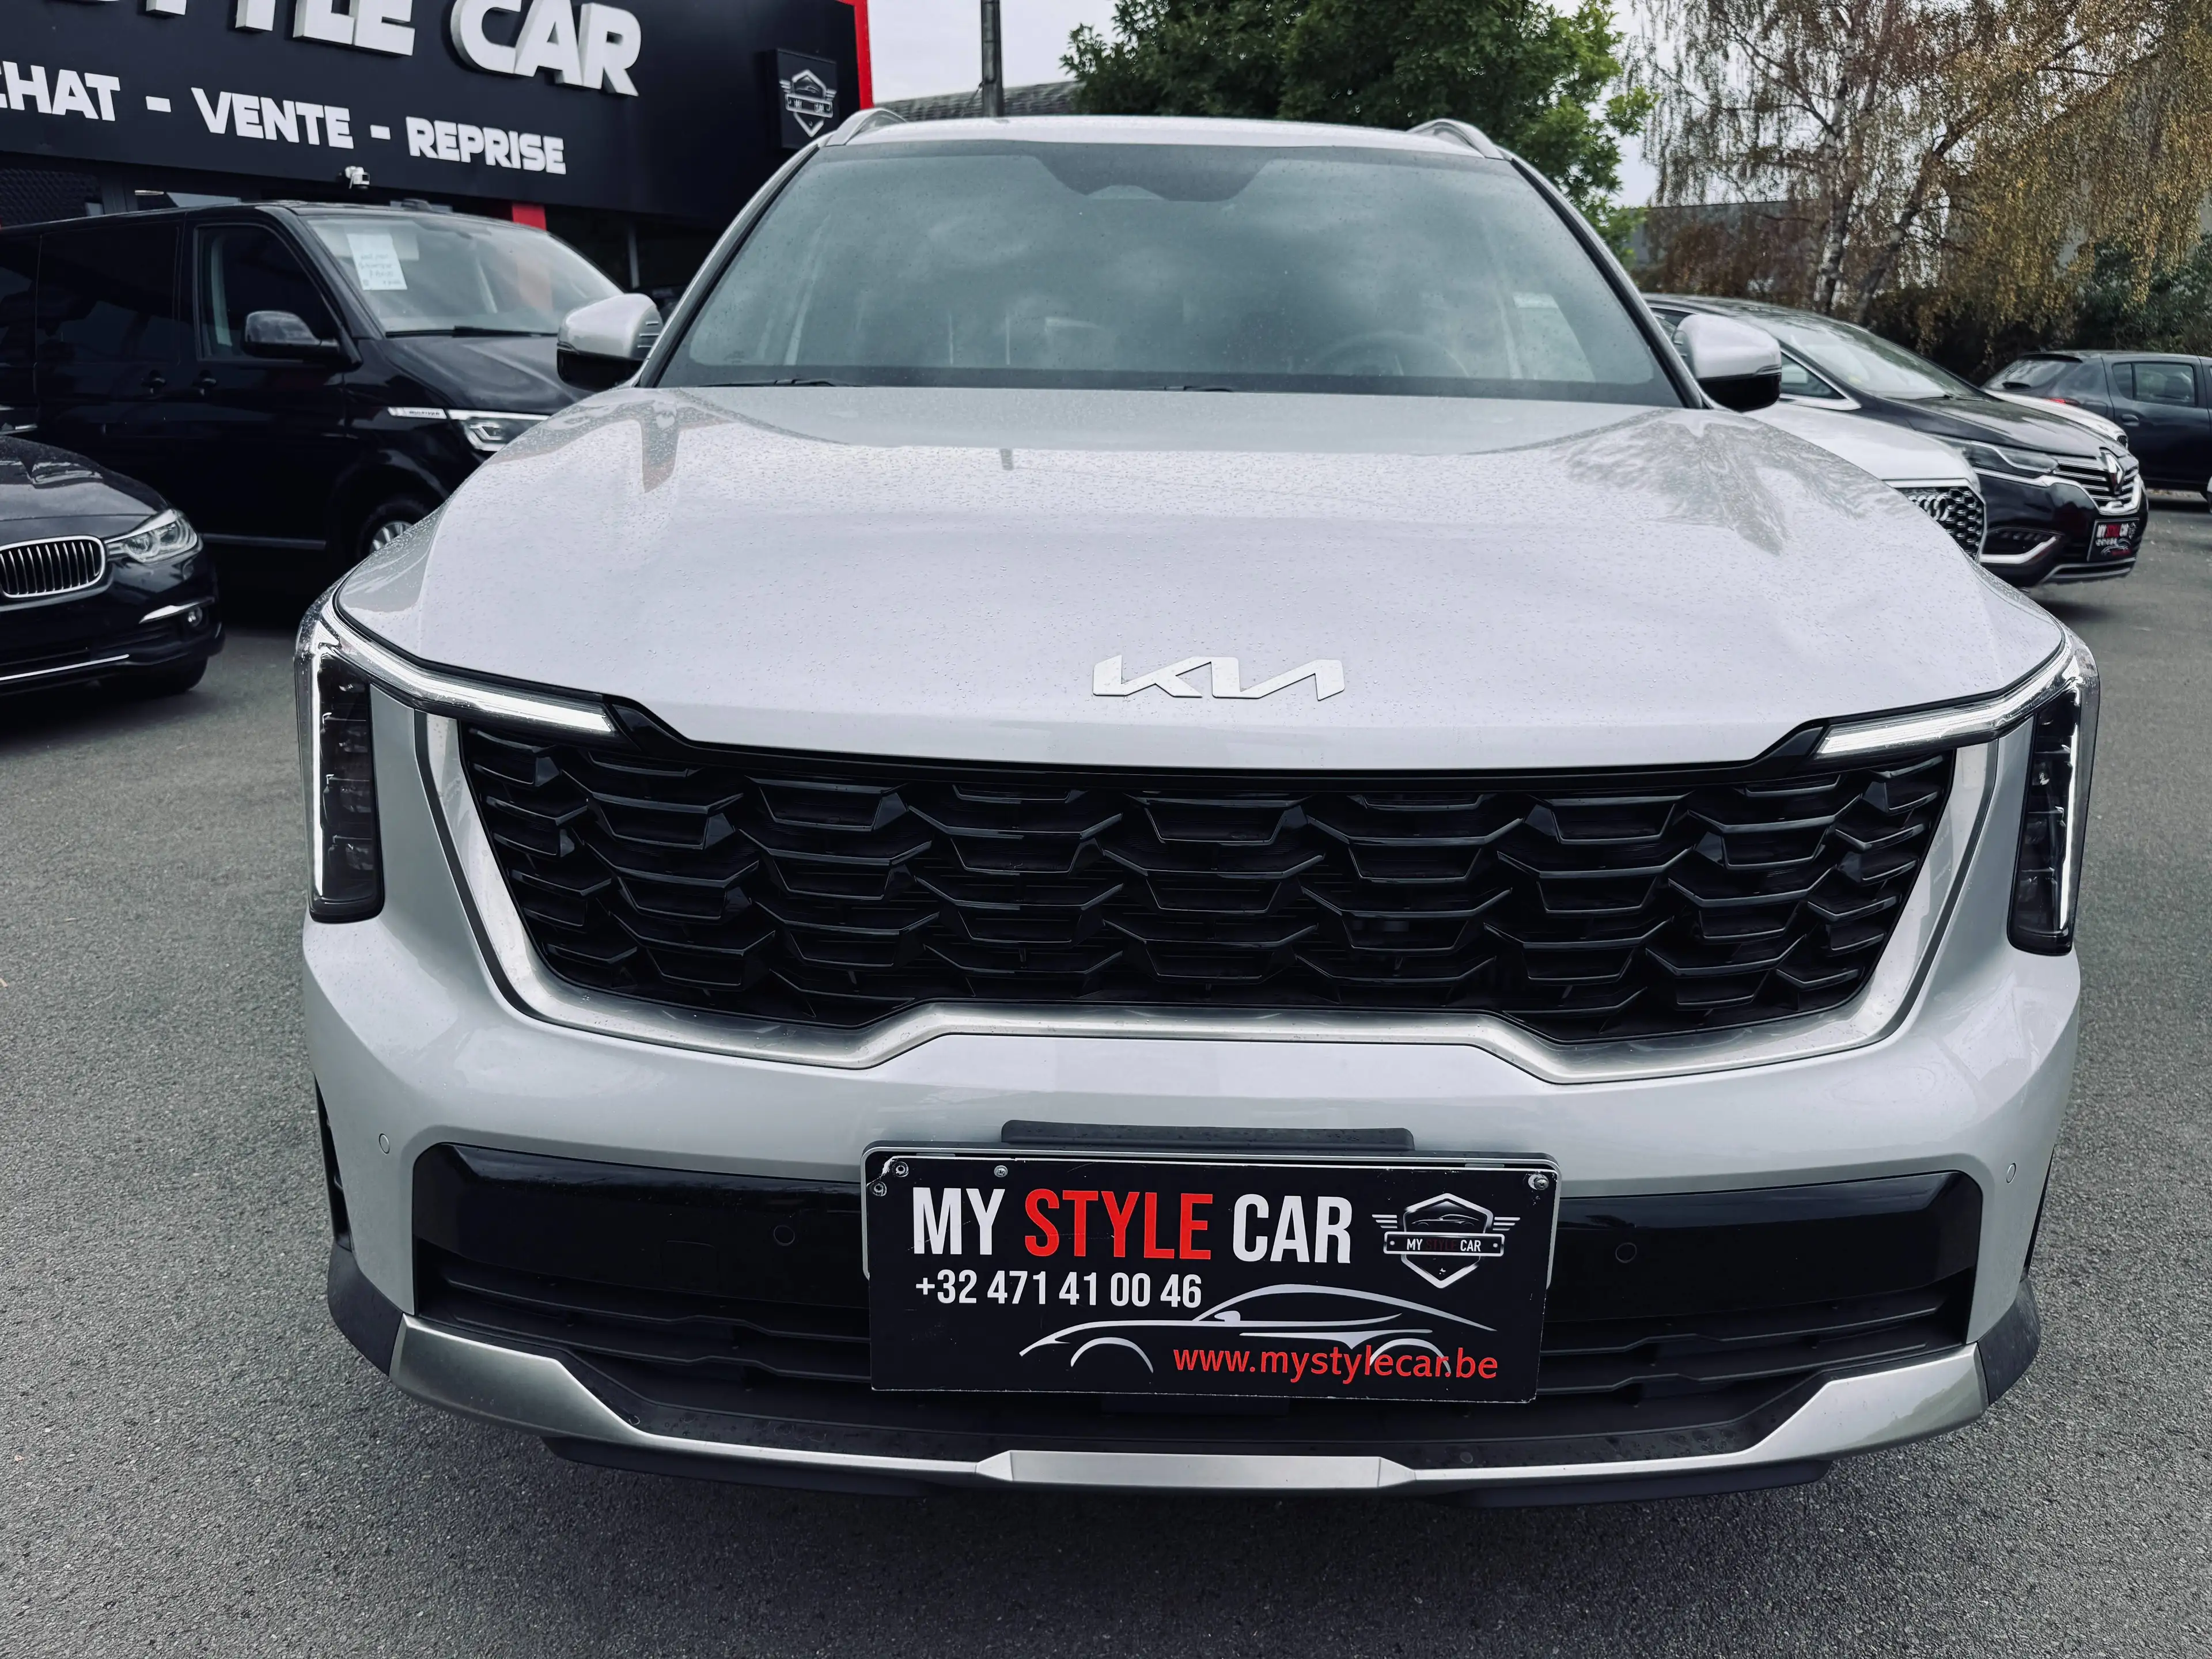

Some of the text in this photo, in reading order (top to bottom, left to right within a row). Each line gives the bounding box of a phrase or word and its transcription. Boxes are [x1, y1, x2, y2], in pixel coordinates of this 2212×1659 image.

[451, 0, 641, 97] CAR
[0, 60, 120, 122] HAT
[191, 87, 354, 149] VENTE
[406, 117, 566, 175] REPRISE
[913, 1187, 1353, 1264] MY STYLE CAR
[1406, 1238, 1423, 1251] MY
[1460, 1240, 1482, 1252] CAR
[916, 1270, 1202, 1308] +32 471 41 00 46
[1173, 1344, 1498, 1384] www.mystylecar.be
